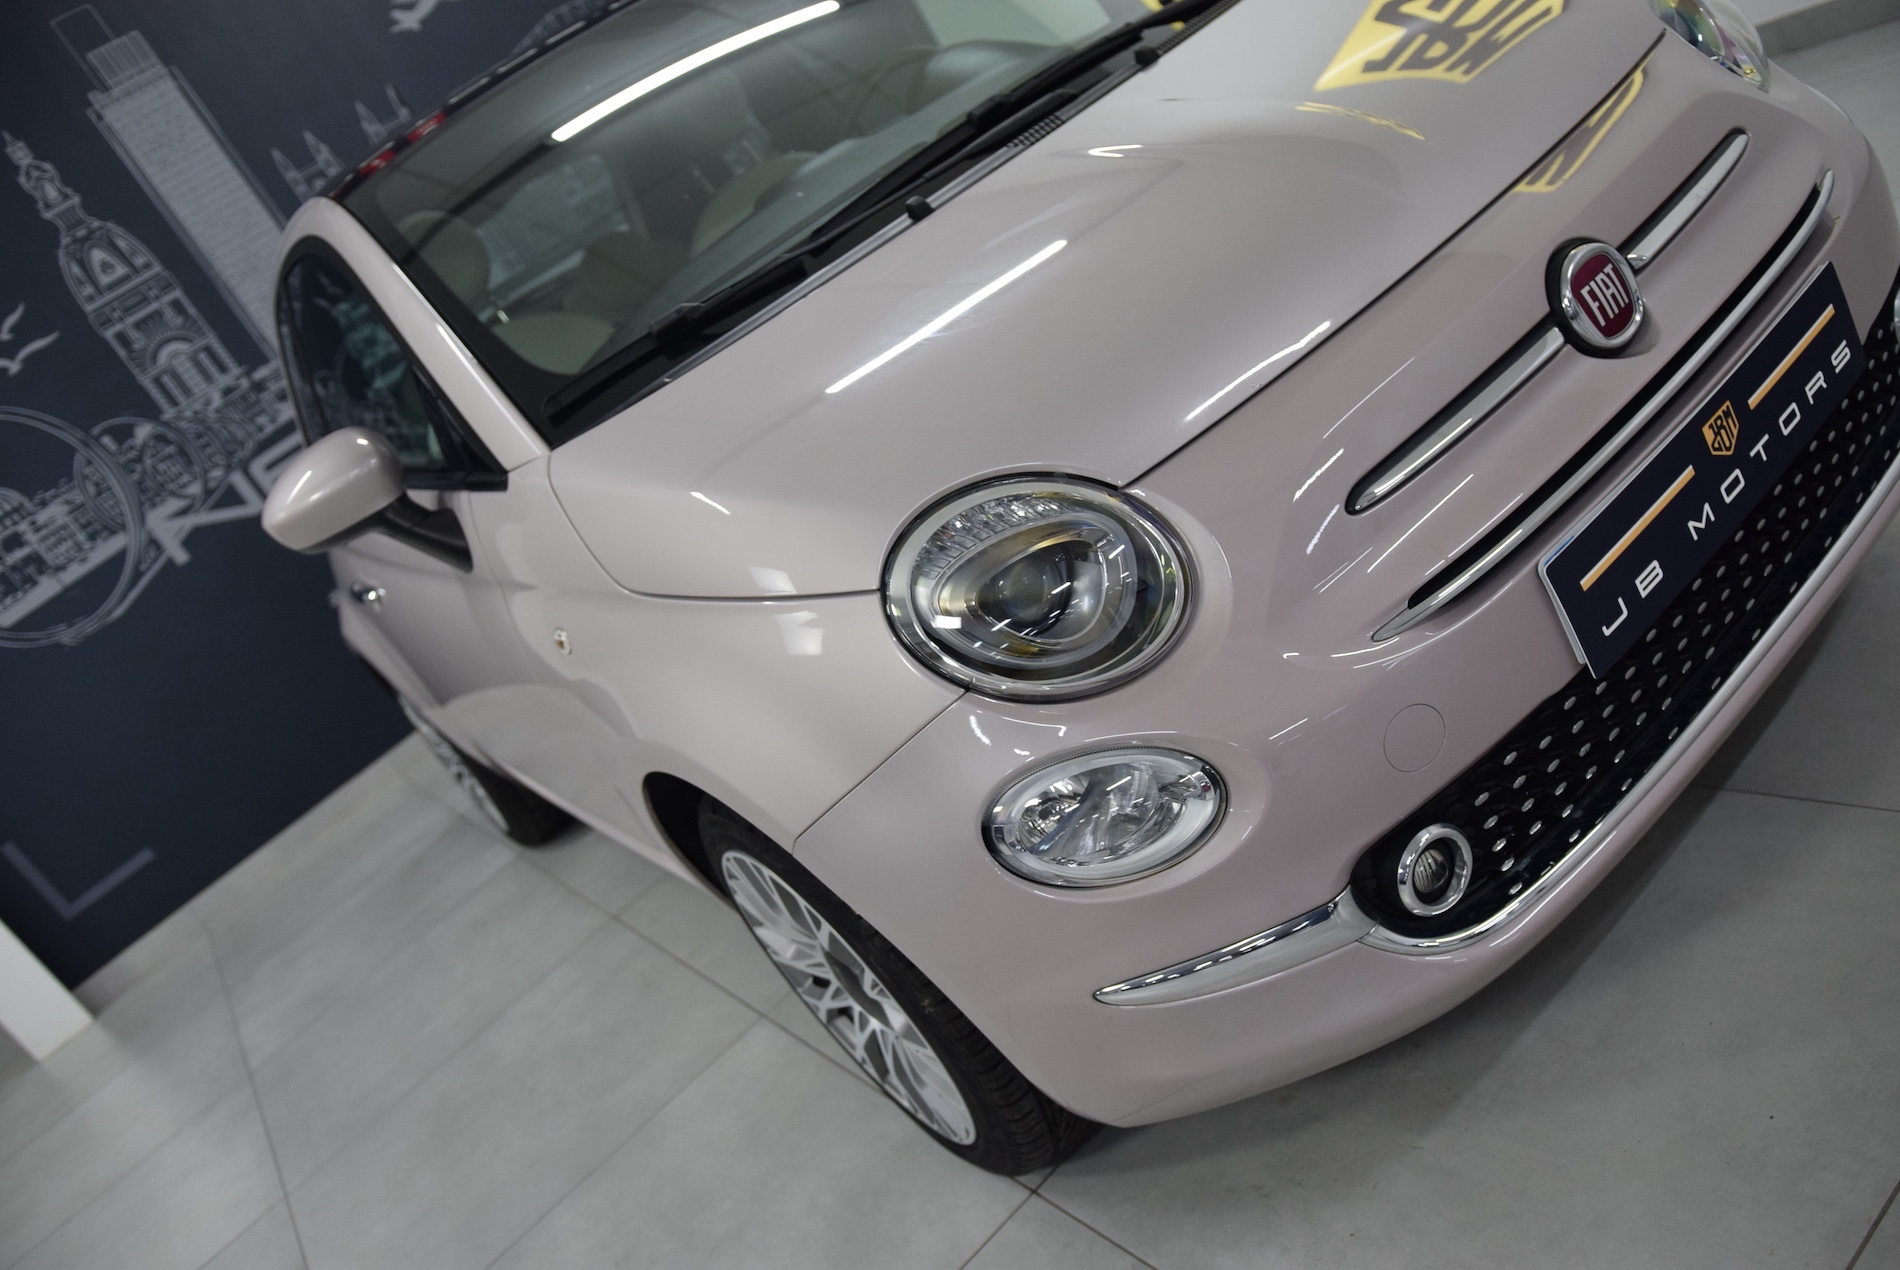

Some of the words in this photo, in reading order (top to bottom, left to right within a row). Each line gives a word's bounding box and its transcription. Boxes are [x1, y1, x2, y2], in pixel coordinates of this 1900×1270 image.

[1580, 263, 1629, 327] FIAT
[1601, 559, 1664, 637] JB
[1687, 339, 1852, 541] MOTORS
